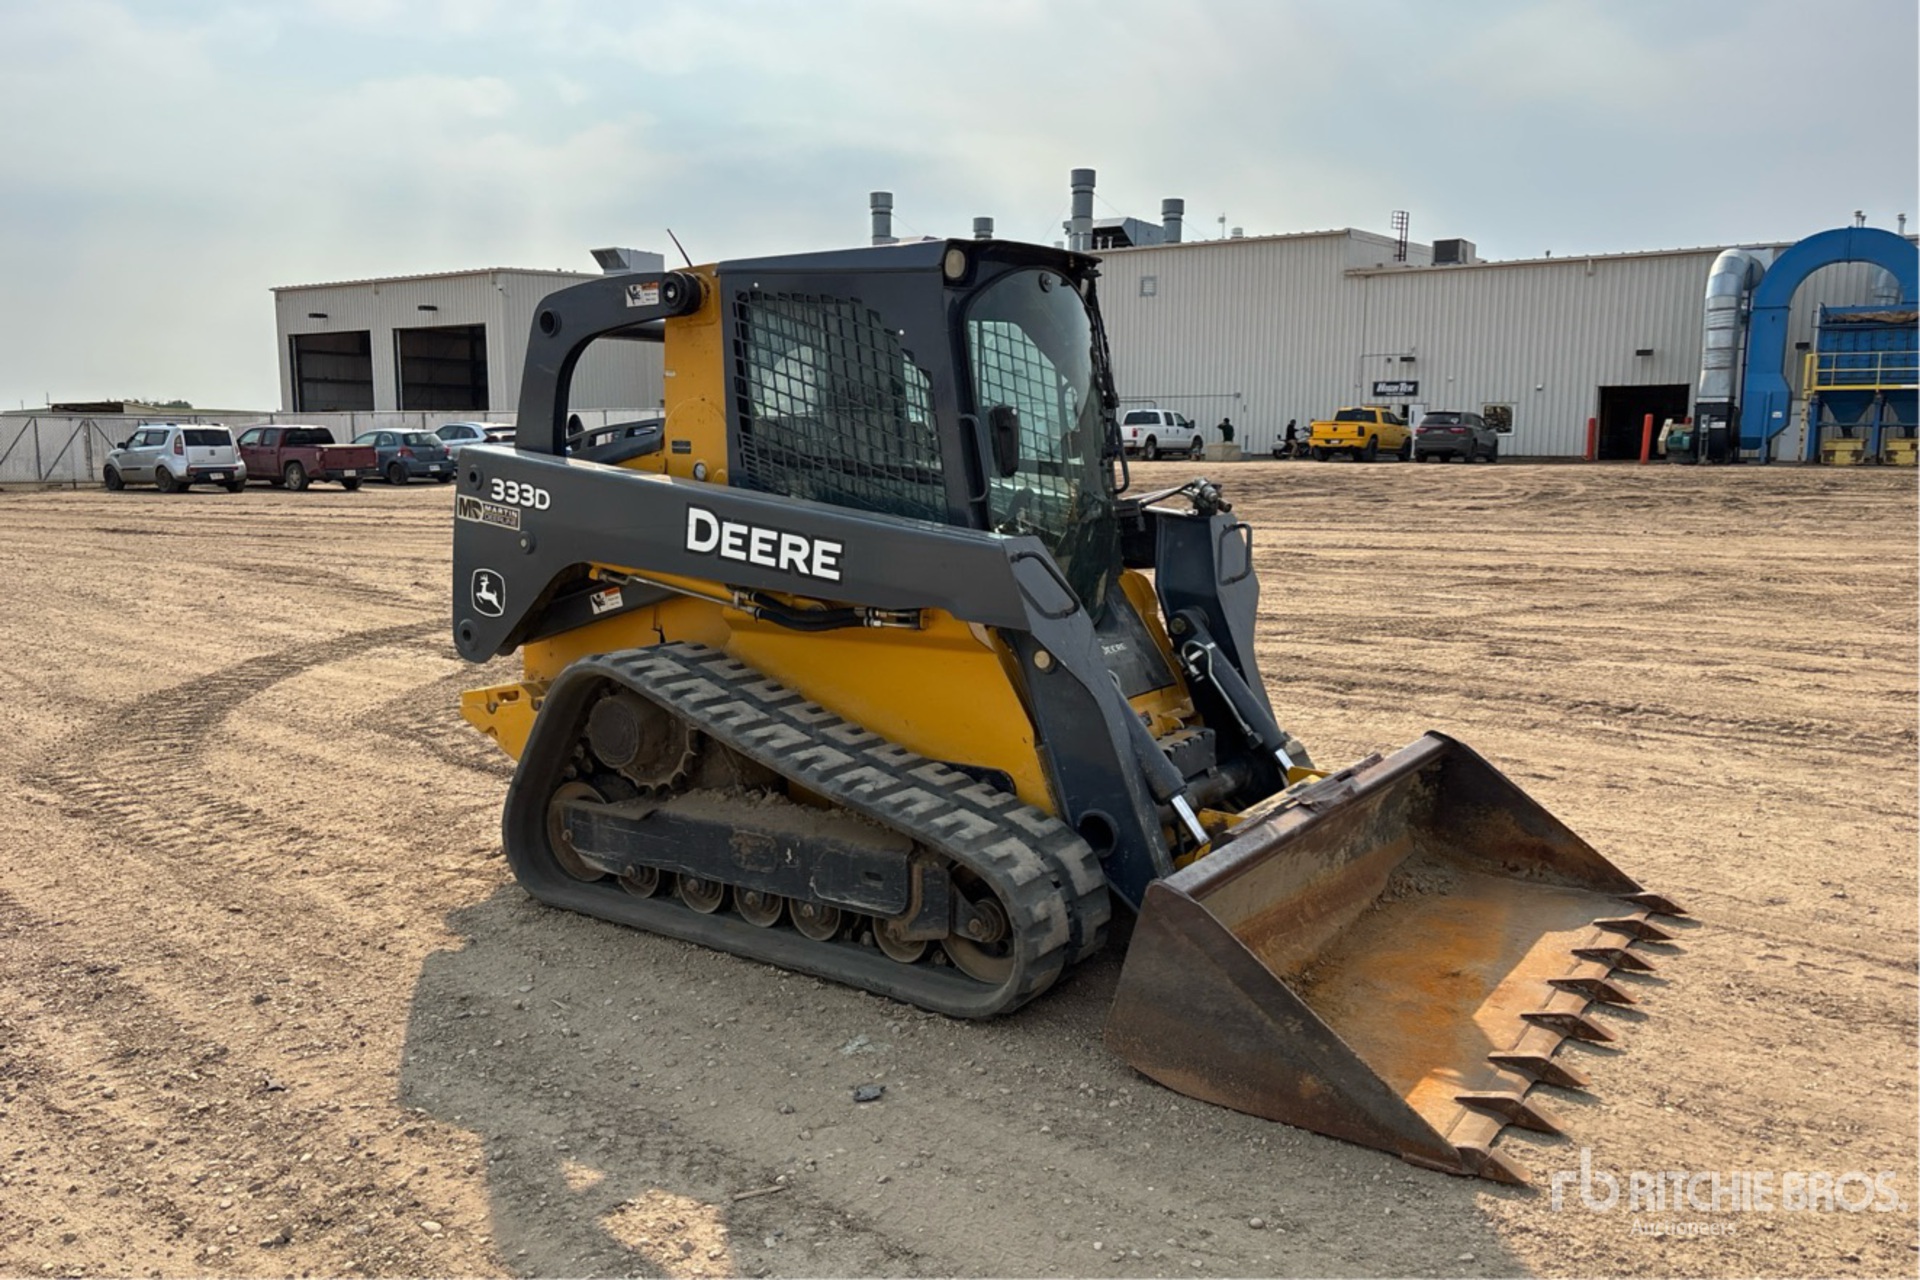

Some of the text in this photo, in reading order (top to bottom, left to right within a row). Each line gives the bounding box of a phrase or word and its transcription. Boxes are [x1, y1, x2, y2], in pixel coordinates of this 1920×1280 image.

[491, 478, 551, 510] 333D
[484, 504, 518, 518] MARTIN
[687, 507, 842, 581] DEERE
